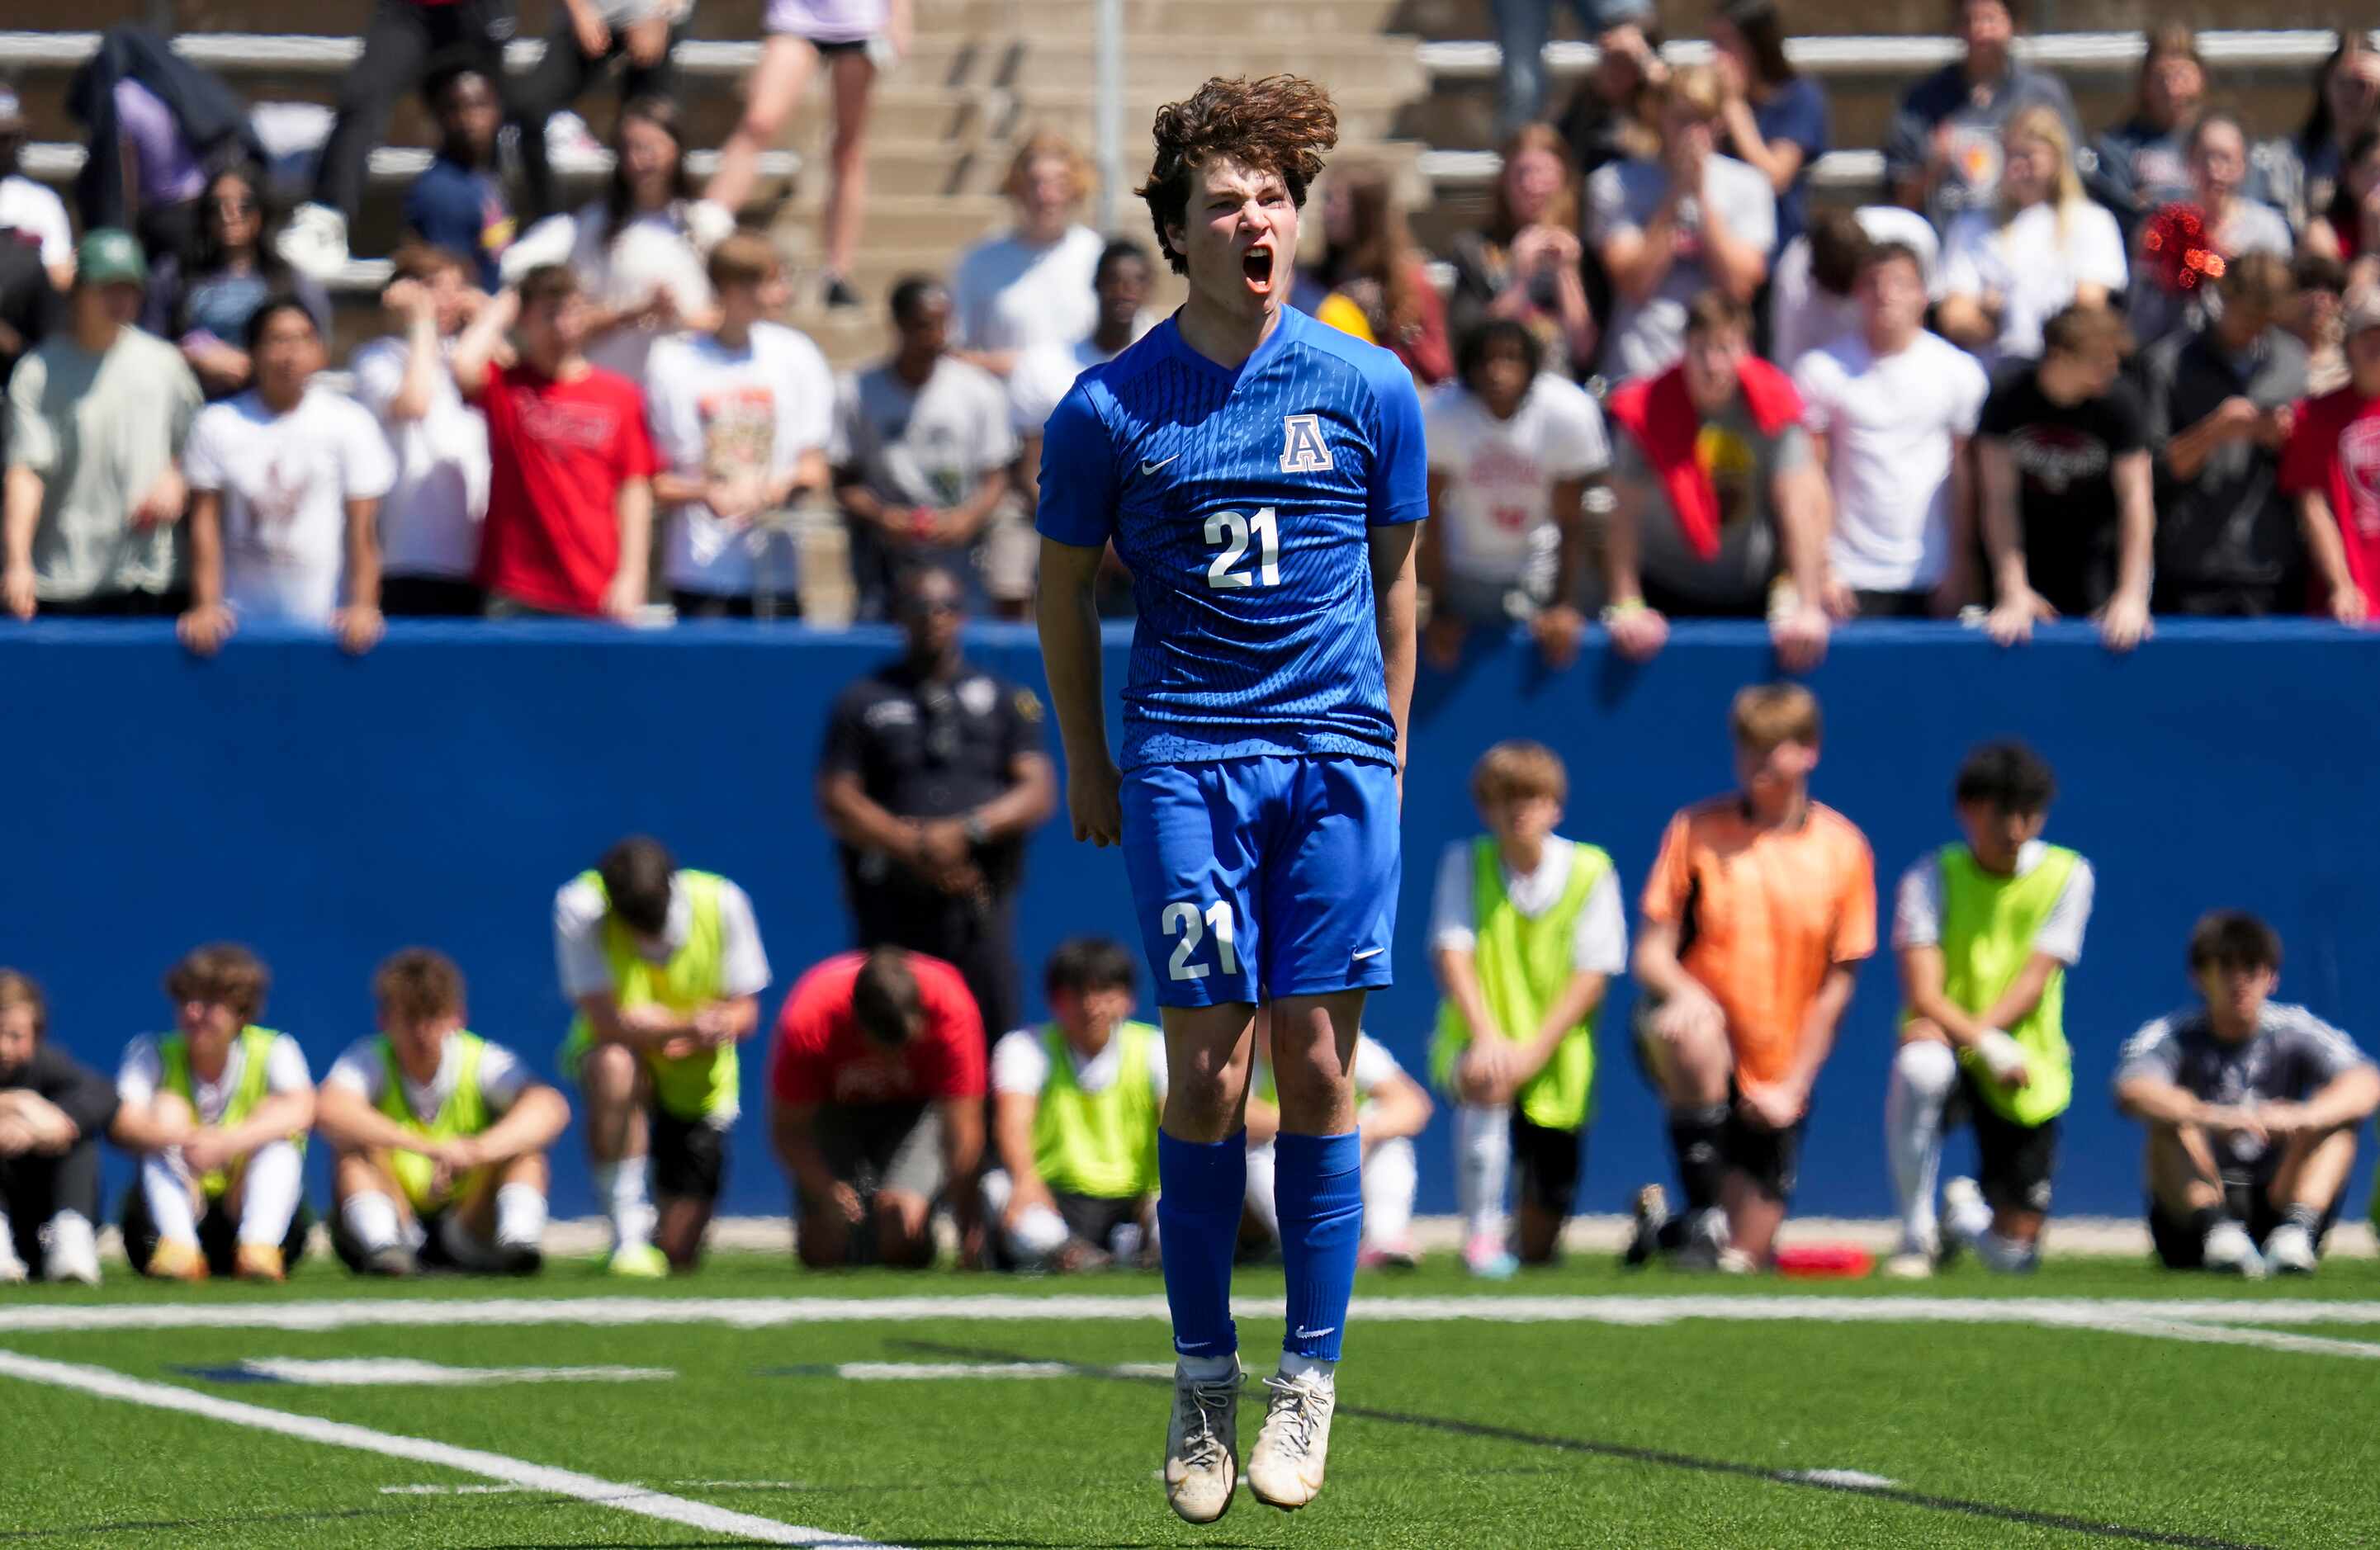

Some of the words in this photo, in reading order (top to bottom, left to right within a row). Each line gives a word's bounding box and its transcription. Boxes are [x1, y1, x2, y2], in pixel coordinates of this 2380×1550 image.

[1281, 415, 1332, 472] A
[1204, 508, 1280, 588] 21
[1162, 900, 1237, 980] 21
